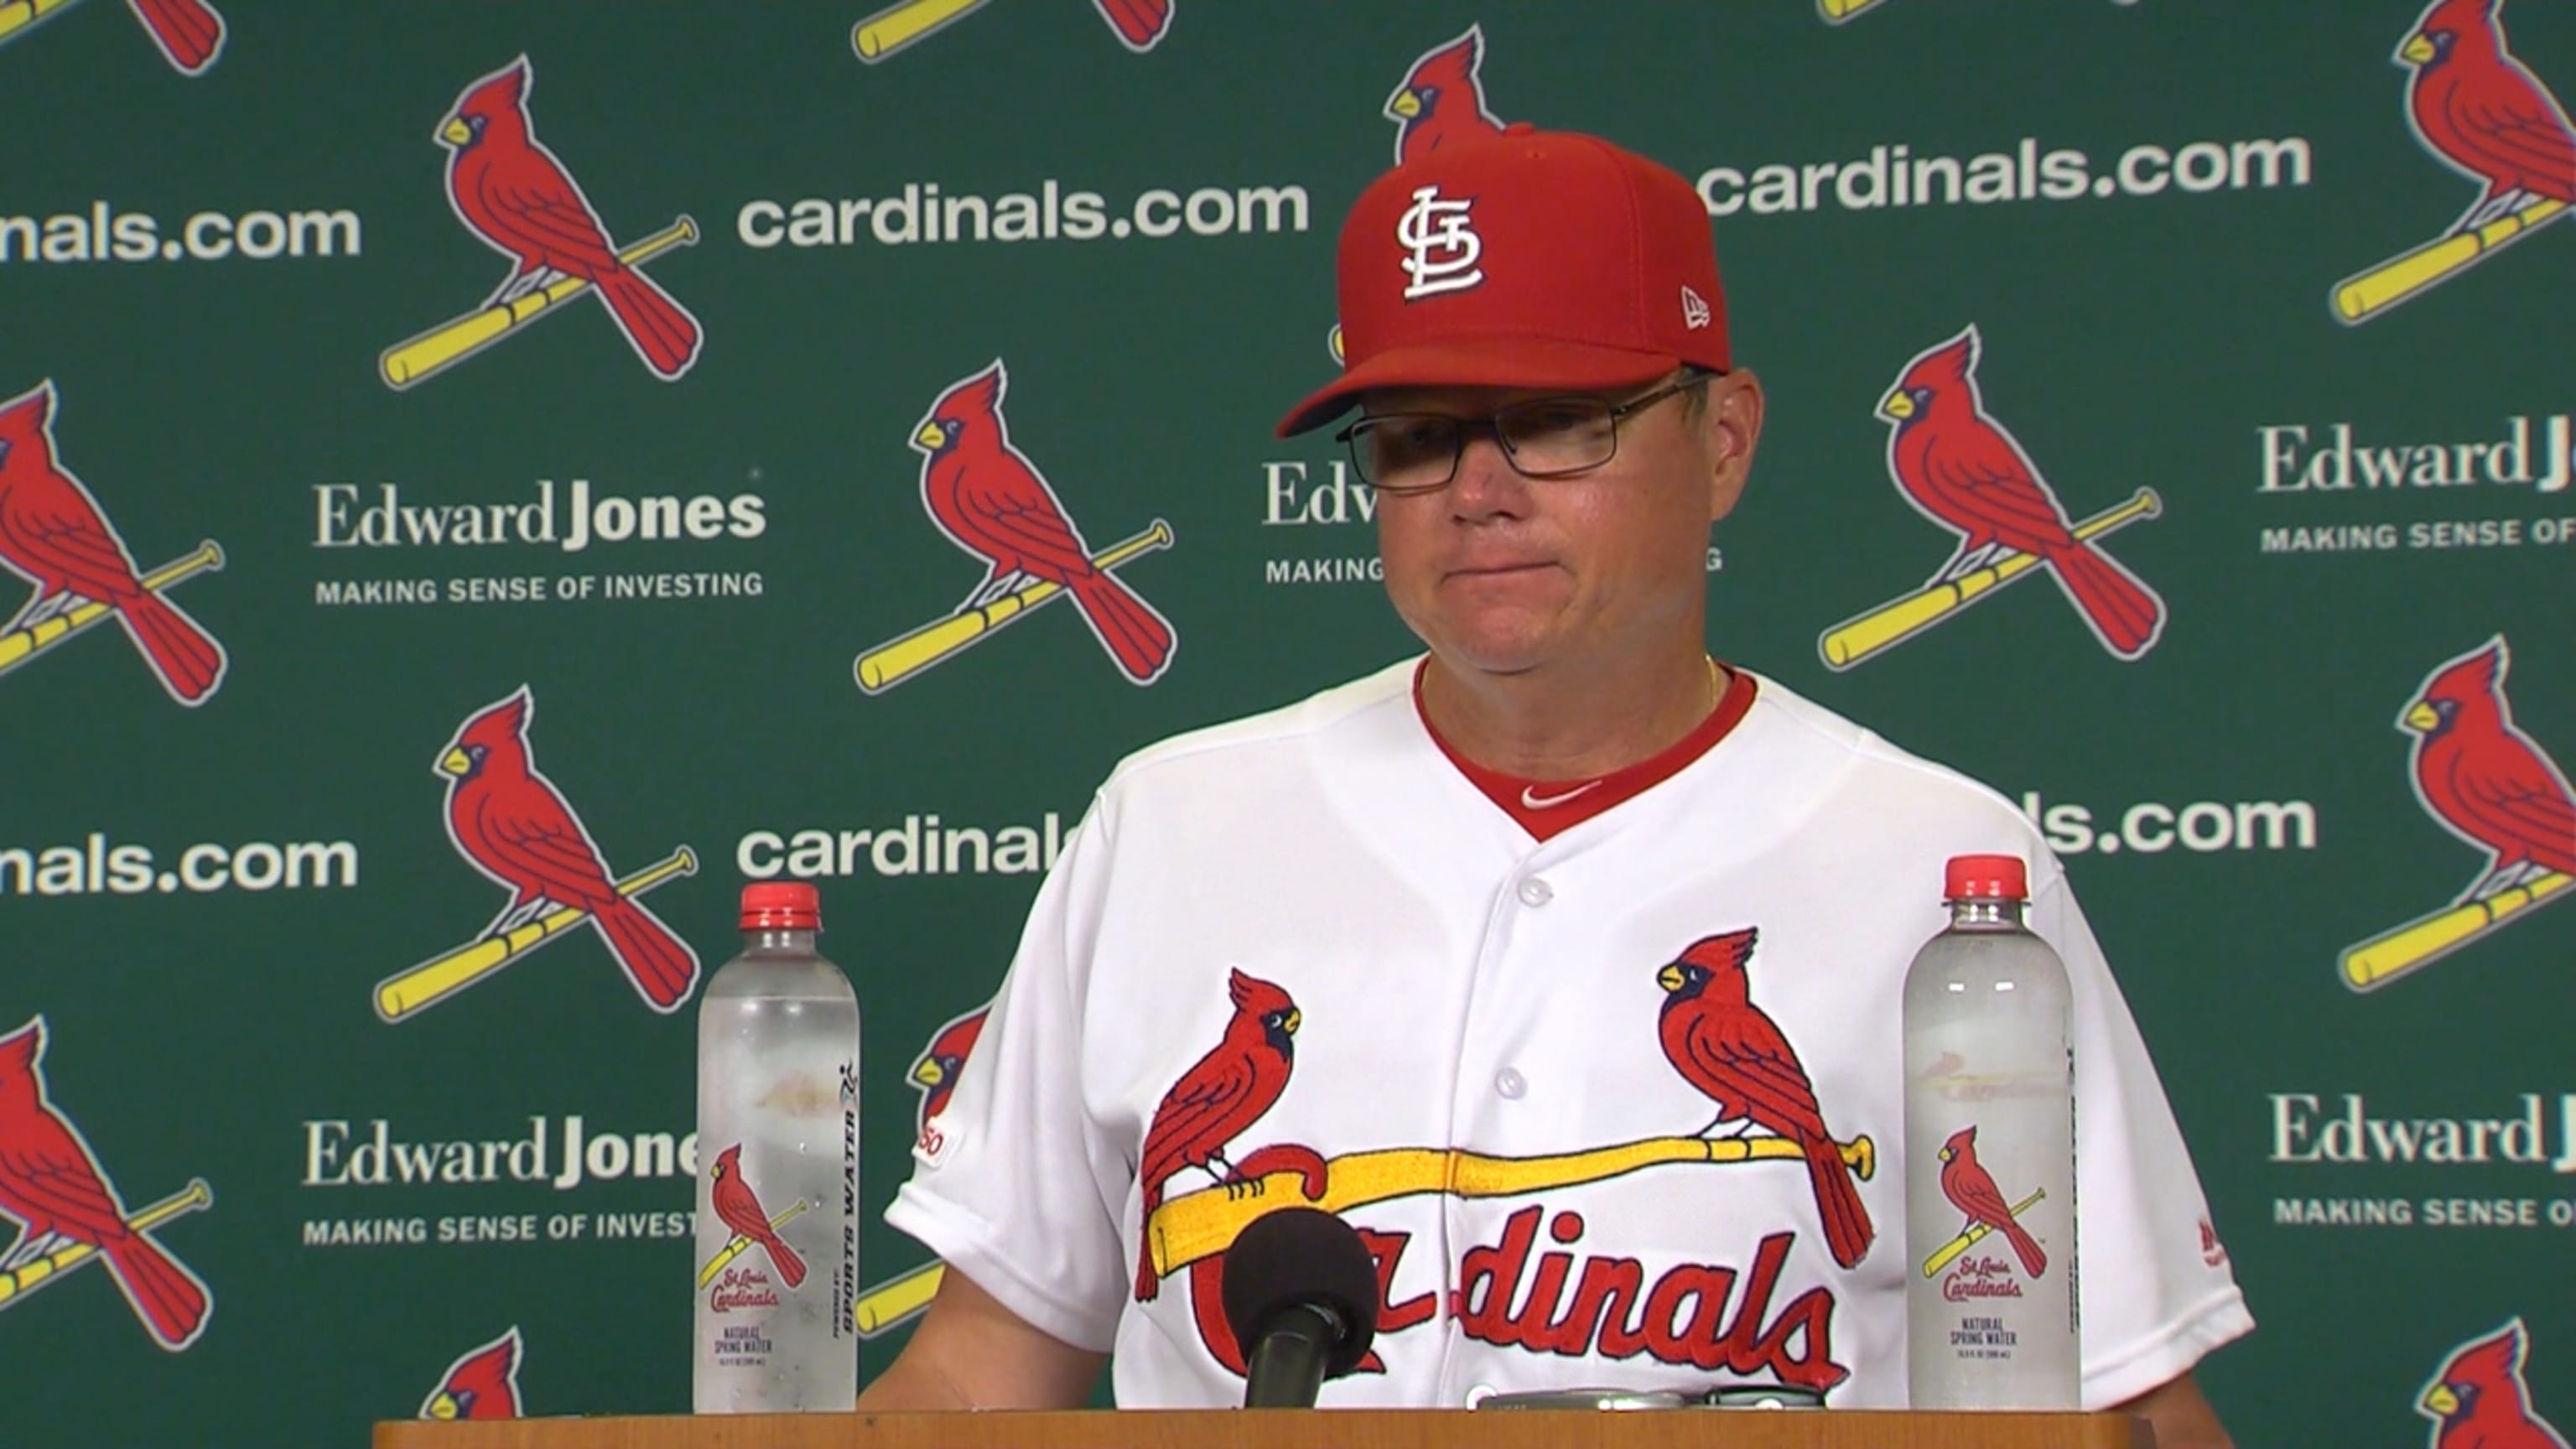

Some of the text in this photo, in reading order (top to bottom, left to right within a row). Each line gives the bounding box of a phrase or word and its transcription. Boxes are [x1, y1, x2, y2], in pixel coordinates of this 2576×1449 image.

[1694, 137, 2312, 216] cardinals.com
[0, 200, 361, 262] nals.com
[736, 179, 1310, 248] cardinals.com
[2255, 414, 2534, 494] Edward
[311, 479, 766, 553] Edward Jones
[2260, 517, 2576, 553] MAKING SENSE OF
[315, 572, 764, 605] MAKING SENSE OF INVESTING
[1265, 556, 1384, 584] MAKING
[0, 831, 359, 896] nals.com
[736, 812, 1080, 879] cardinal
[300, 1115, 550, 1187] Edward
[2267, 1093, 2548, 1163] Edward
[303, 1219, 428, 1246] MAKING
[437, 1215, 538, 1242] SENSE
[547, 1213, 588, 1239] OF
[842, 1109, 855, 1336] SPORTS WATER
[2273, 1197, 2576, 1226] MAKING SENSE O
[1189, 1143, 1852, 1389] Crdinals
[1943, 1271, 2023, 1303] Cardinals
[710, 1284, 781, 1313] Cardinals
[723, 1326, 761, 1340] NATURAL
[743, 1339, 772, 1353] WATER
[1950, 1330, 2017, 1345] SPRING WATER
[1961, 1317, 2003, 1331] NATURAL
